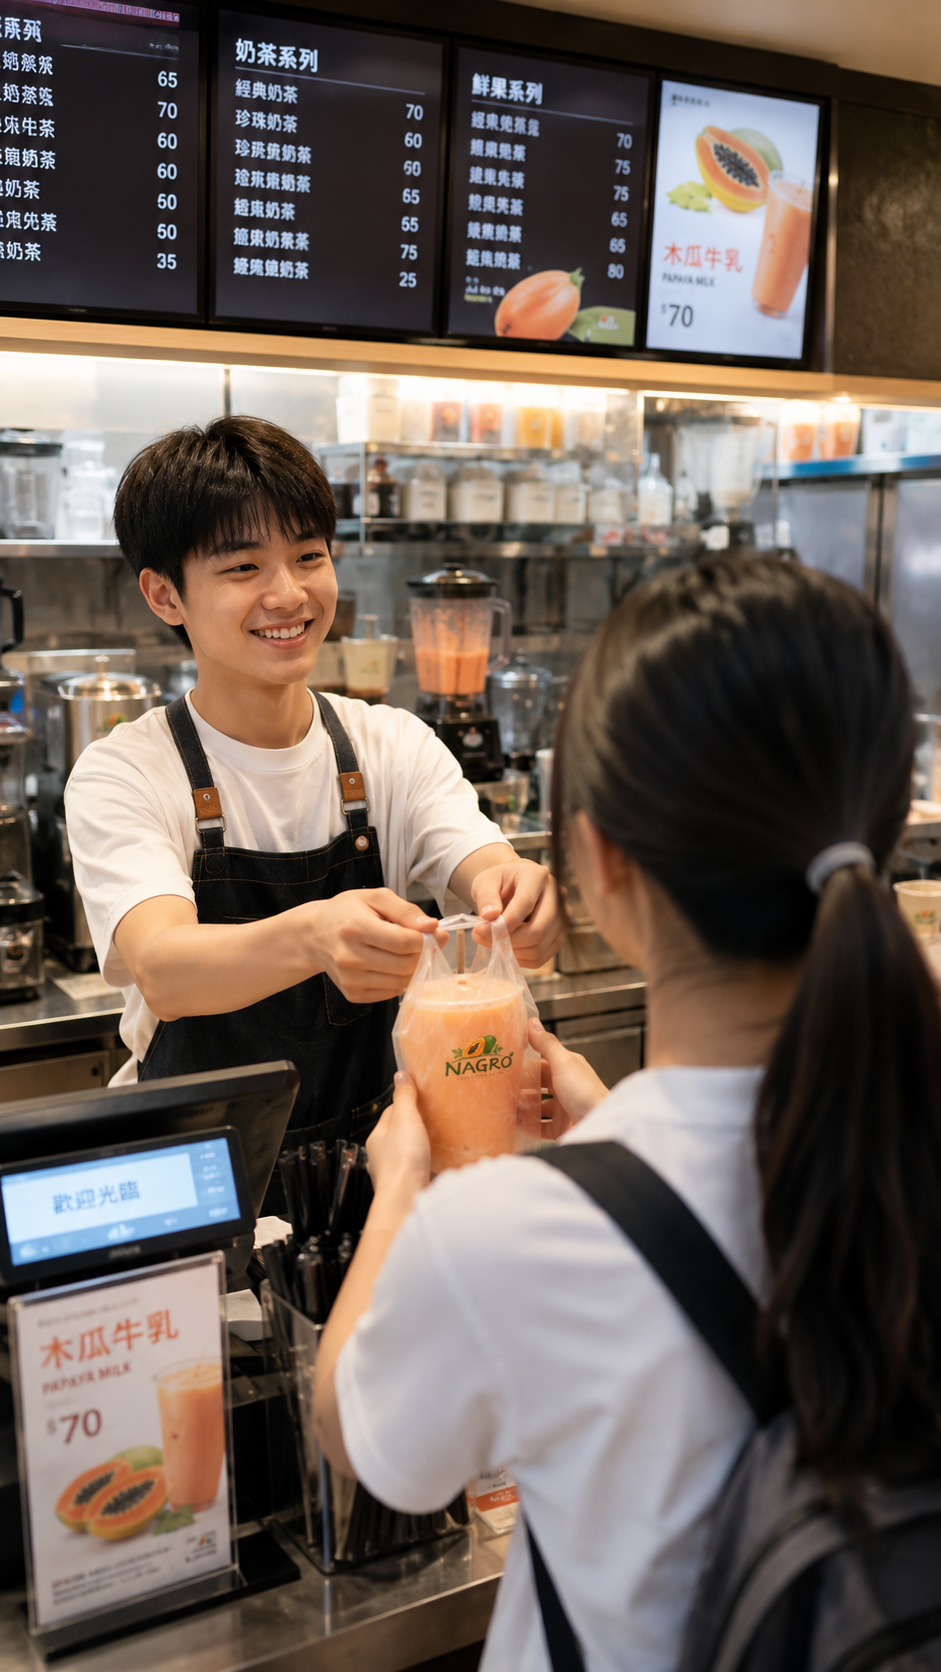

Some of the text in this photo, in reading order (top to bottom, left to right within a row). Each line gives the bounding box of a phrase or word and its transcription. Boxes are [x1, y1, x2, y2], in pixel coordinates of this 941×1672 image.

[235, 38, 319, 73] 奶茶系列
[157, 71, 178, 88] 65
[471, 72, 544, 105] 鮮果系列
[235, 78, 424, 121] 經典奶茶 70
[157, 101, 178, 119] 70
[235, 109, 423, 149] 珍珠奶茶 60
[157, 132, 178, 150] 60
[616, 132, 633, 149] 70
[157, 163, 178, 180] 60
[614, 159, 631, 176] 75
[0, 178, 41, 200] 奶茶
[402, 188, 420, 205] 65
[613, 185, 629, 202] 75
[156, 253, 177, 270] 35
[400, 244, 418, 261] 75
[663, 241, 743, 273] 木瓜牛乳
[398, 271, 417, 288] 25
[607, 263, 624, 280] 80
[445, 1055, 512, 1077] NAGRO
[52, 1180, 141, 1214] 歡迎光臨
[40, 1309, 179, 1370] 木瓜牛乳
[42, 1369, 95, 1396] PAPAYA
